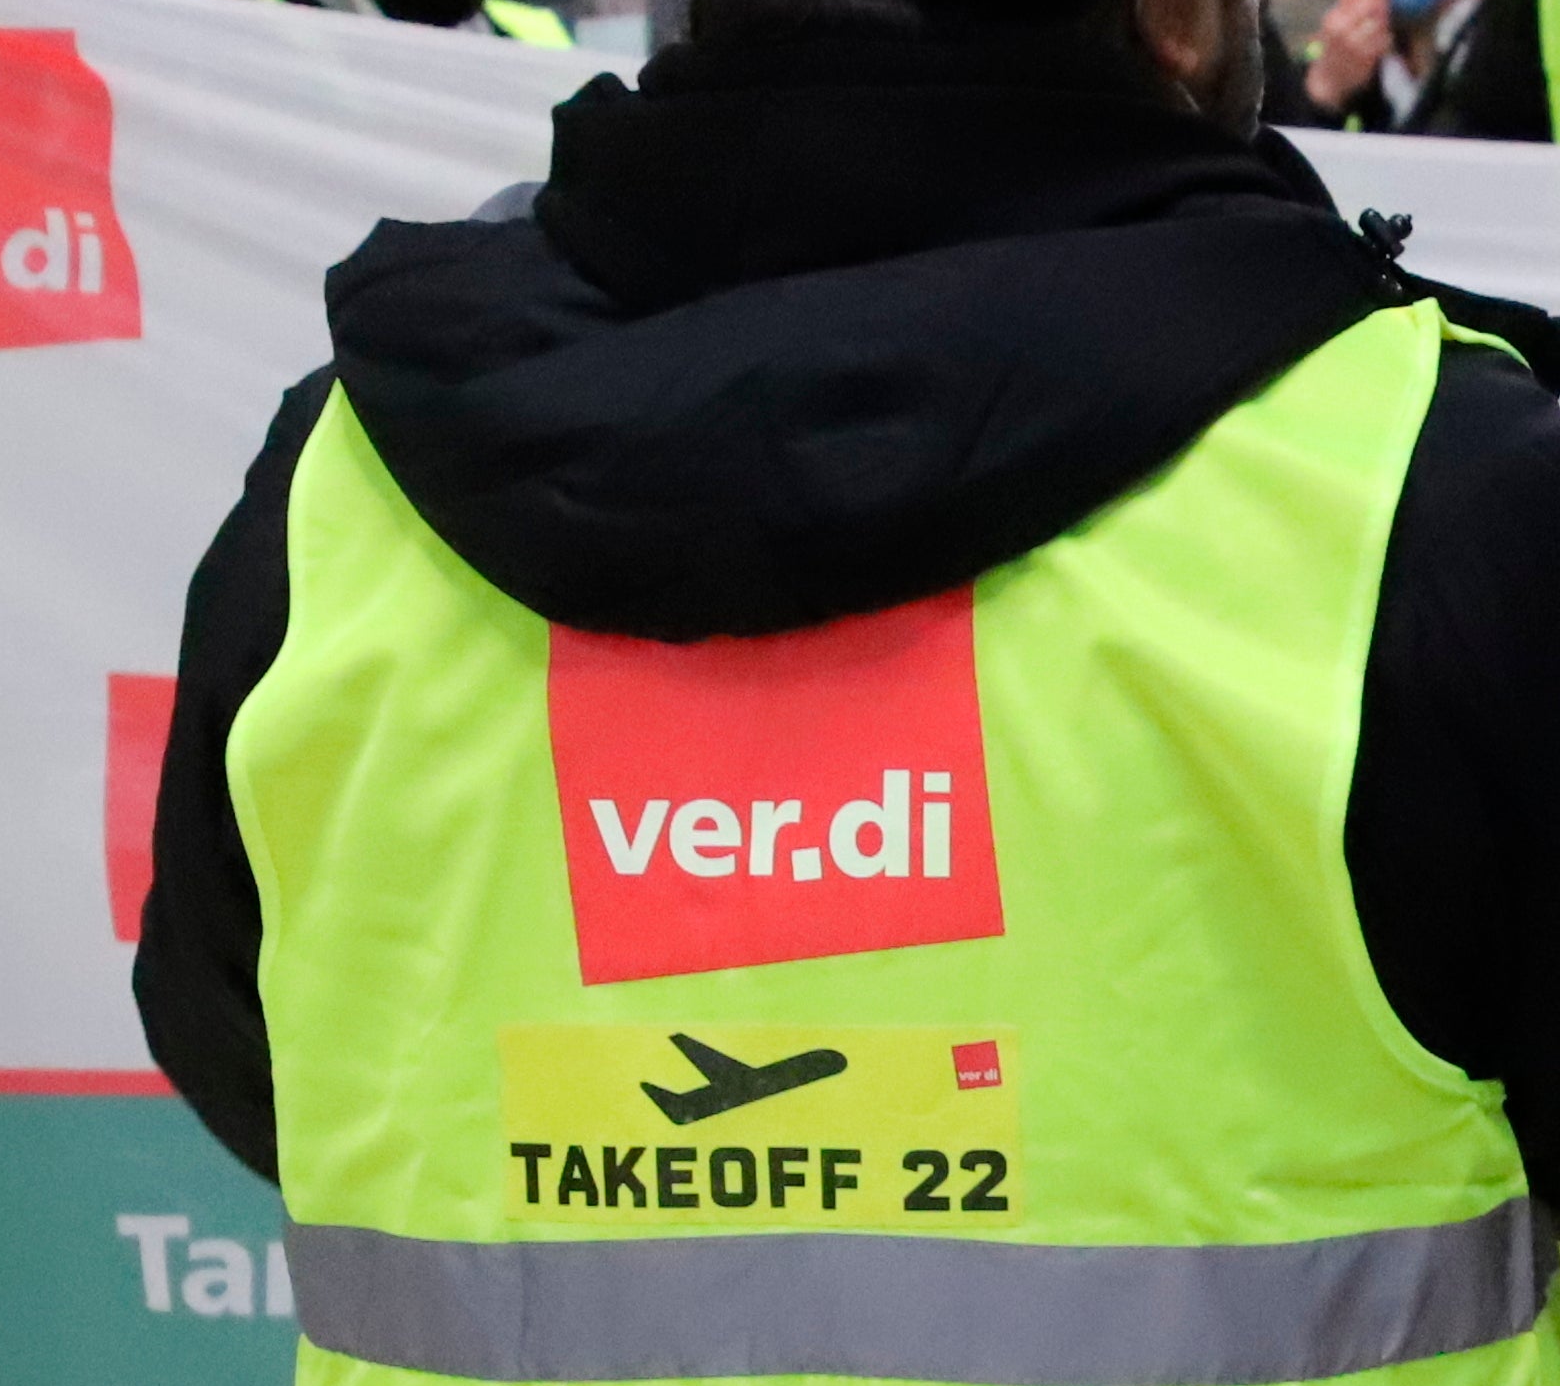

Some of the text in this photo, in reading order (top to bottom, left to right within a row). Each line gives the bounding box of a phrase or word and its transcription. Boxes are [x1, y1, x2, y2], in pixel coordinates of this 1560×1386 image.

[589, 769, 952, 881] ver.di
[510, 1142, 1009, 1211] TAKEOFF 22
